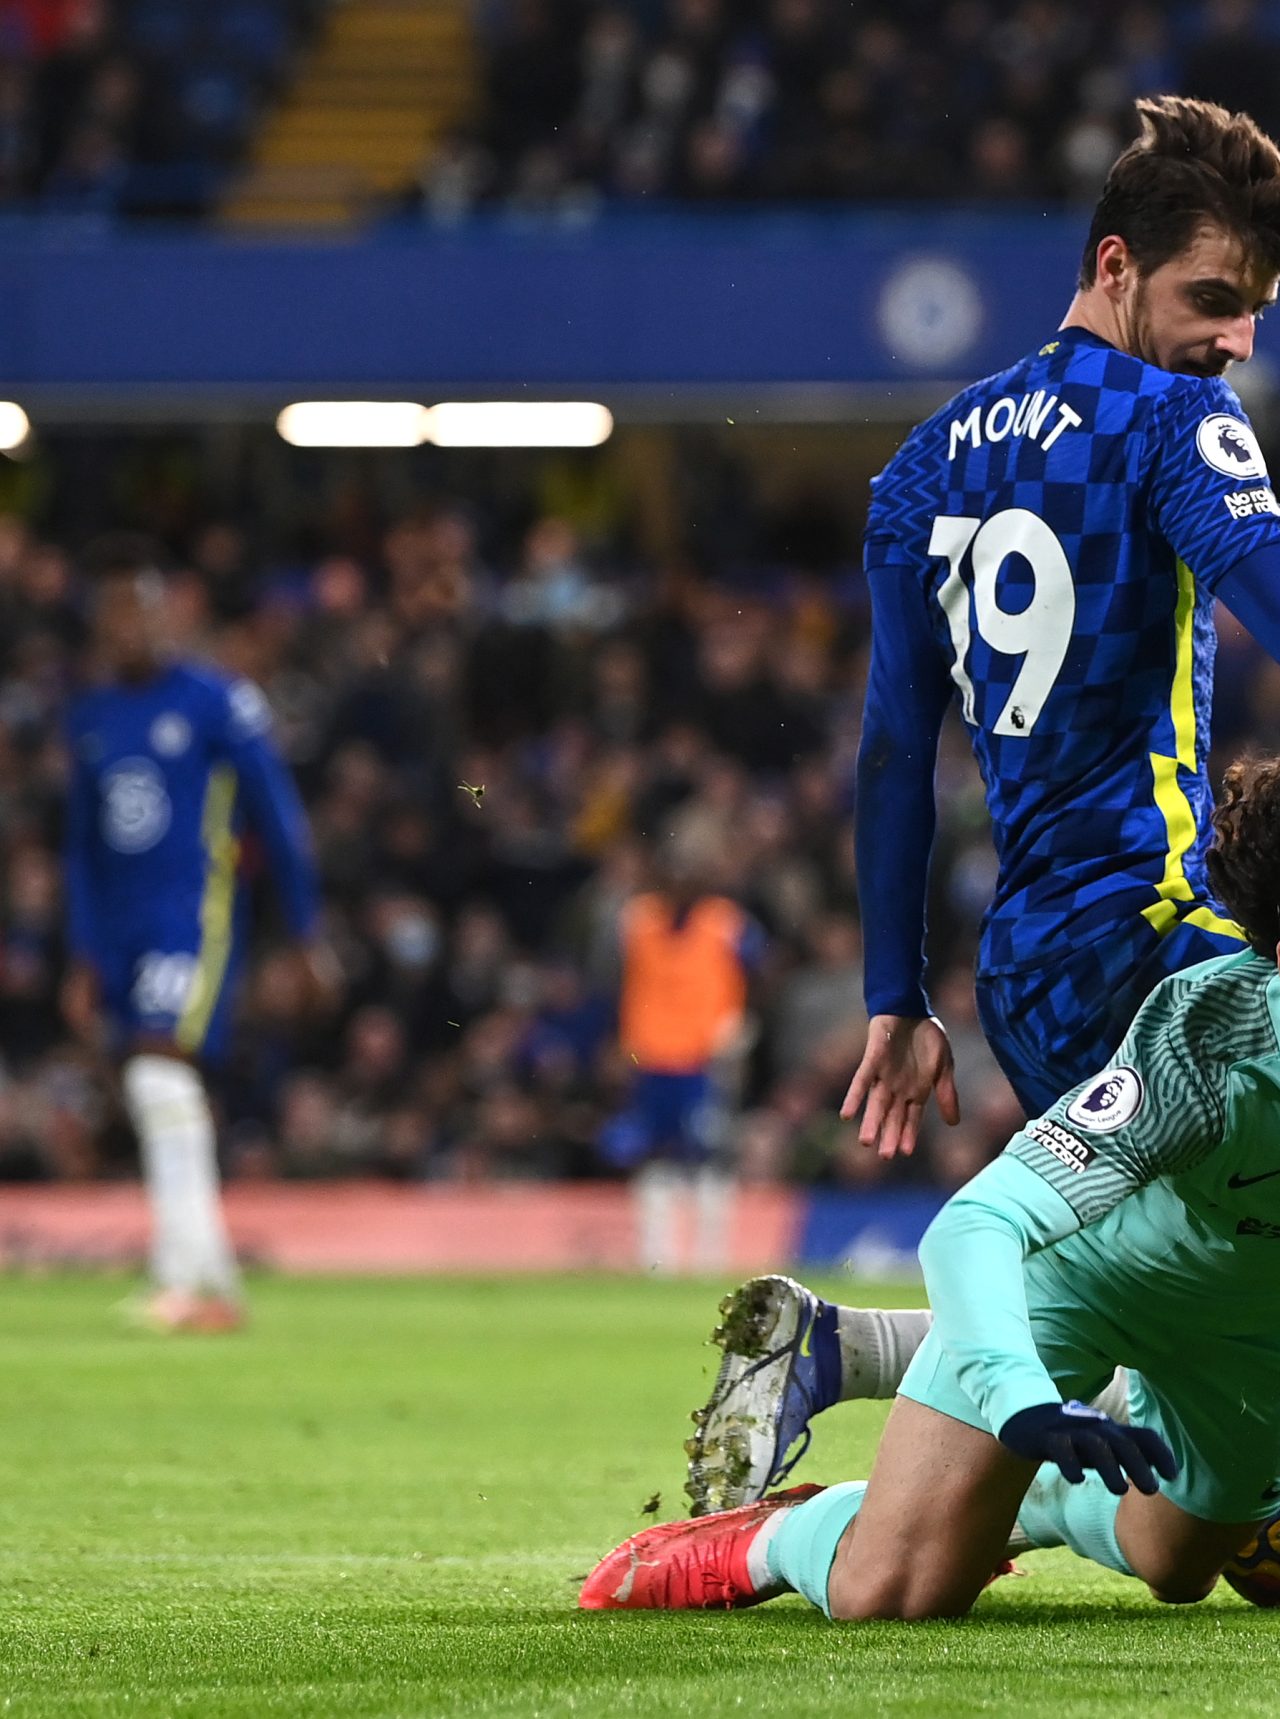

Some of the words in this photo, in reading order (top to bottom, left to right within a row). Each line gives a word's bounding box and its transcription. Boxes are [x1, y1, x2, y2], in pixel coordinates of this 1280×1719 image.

[947, 389, 1083, 461] MOUNT
[927, 507, 1076, 738] 19
[1050, 1123, 1089, 1161] room
